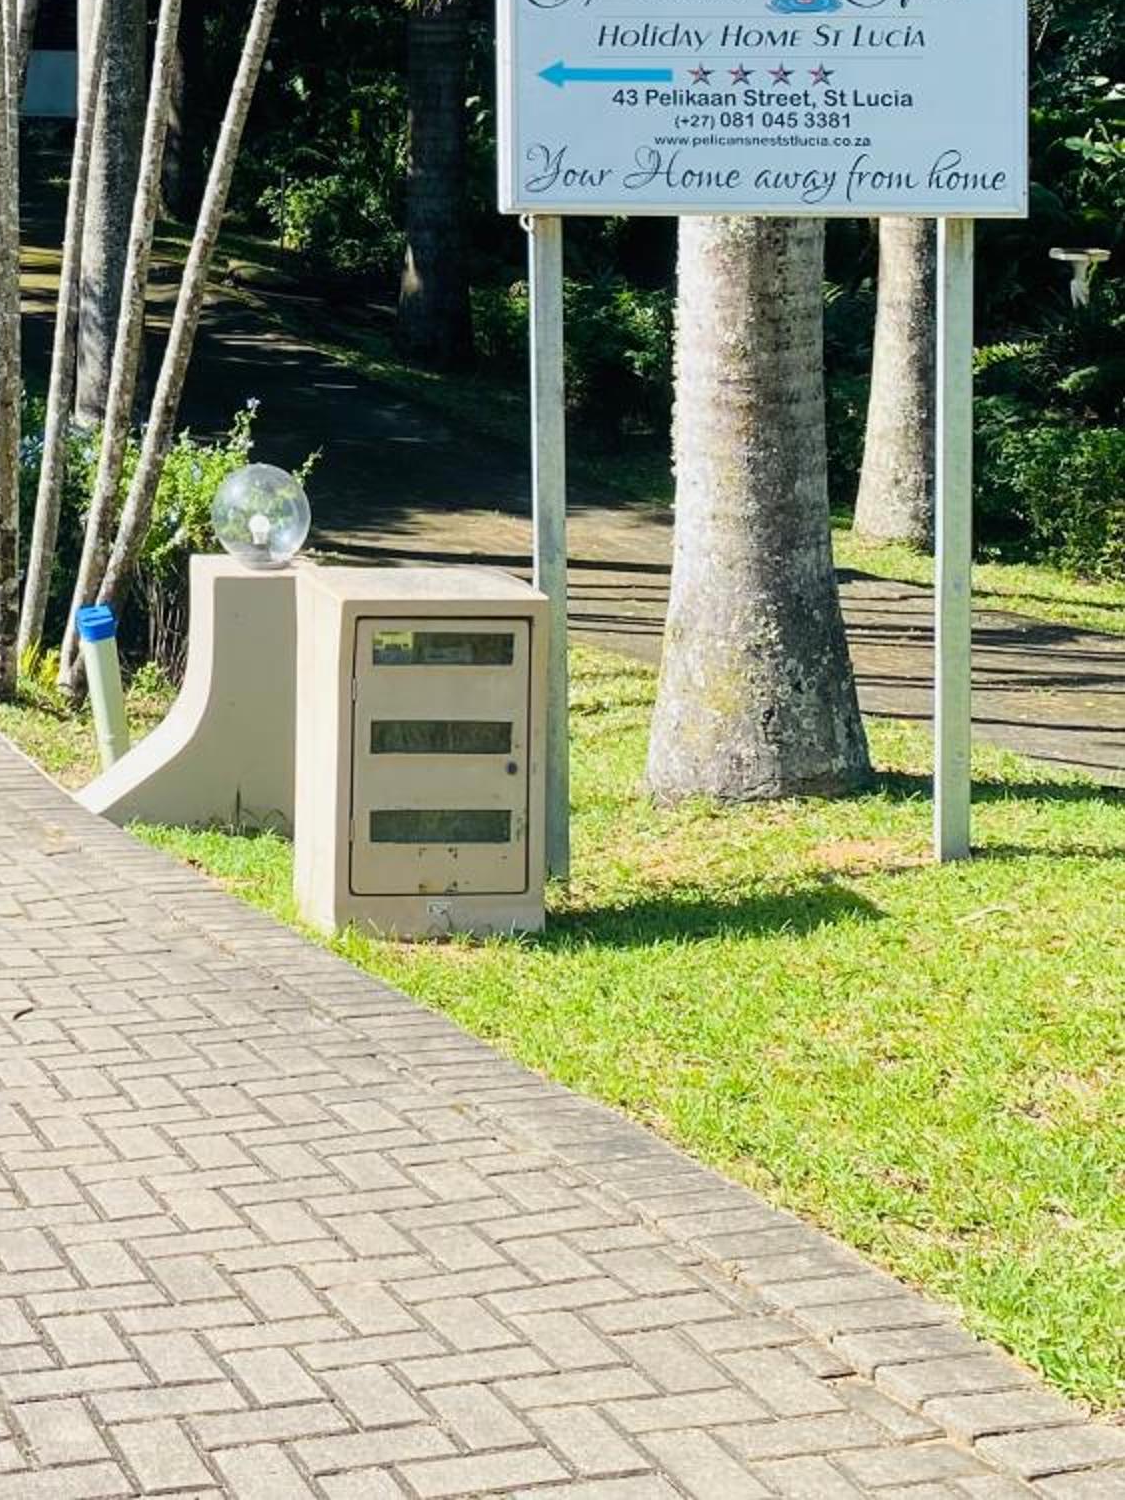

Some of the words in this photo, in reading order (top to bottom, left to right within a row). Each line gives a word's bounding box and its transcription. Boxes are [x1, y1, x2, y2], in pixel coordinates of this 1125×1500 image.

[597, 22, 712, 51] Holiday
[612, 88, 639, 107] 43
[645, 88, 737, 107] Pelikaan
[743, 88, 817, 109] Street,
[824, 89, 847, 108] St
[853, 89, 914, 108] Lucia
[674, 114, 716, 131] (+27)
[719, 111, 755, 129] 081
[761, 111, 799, 129] 045
[804, 111, 852, 129] 3381
[653, 133, 872, 148] www.pelicansneststlucia.co.za
[524, 143, 612, 194] Your
[622, 145, 743, 190] Home
[754, 167, 837, 205] away
[844, 153, 918, 203] from
[926, 148, 1008, 192] home
